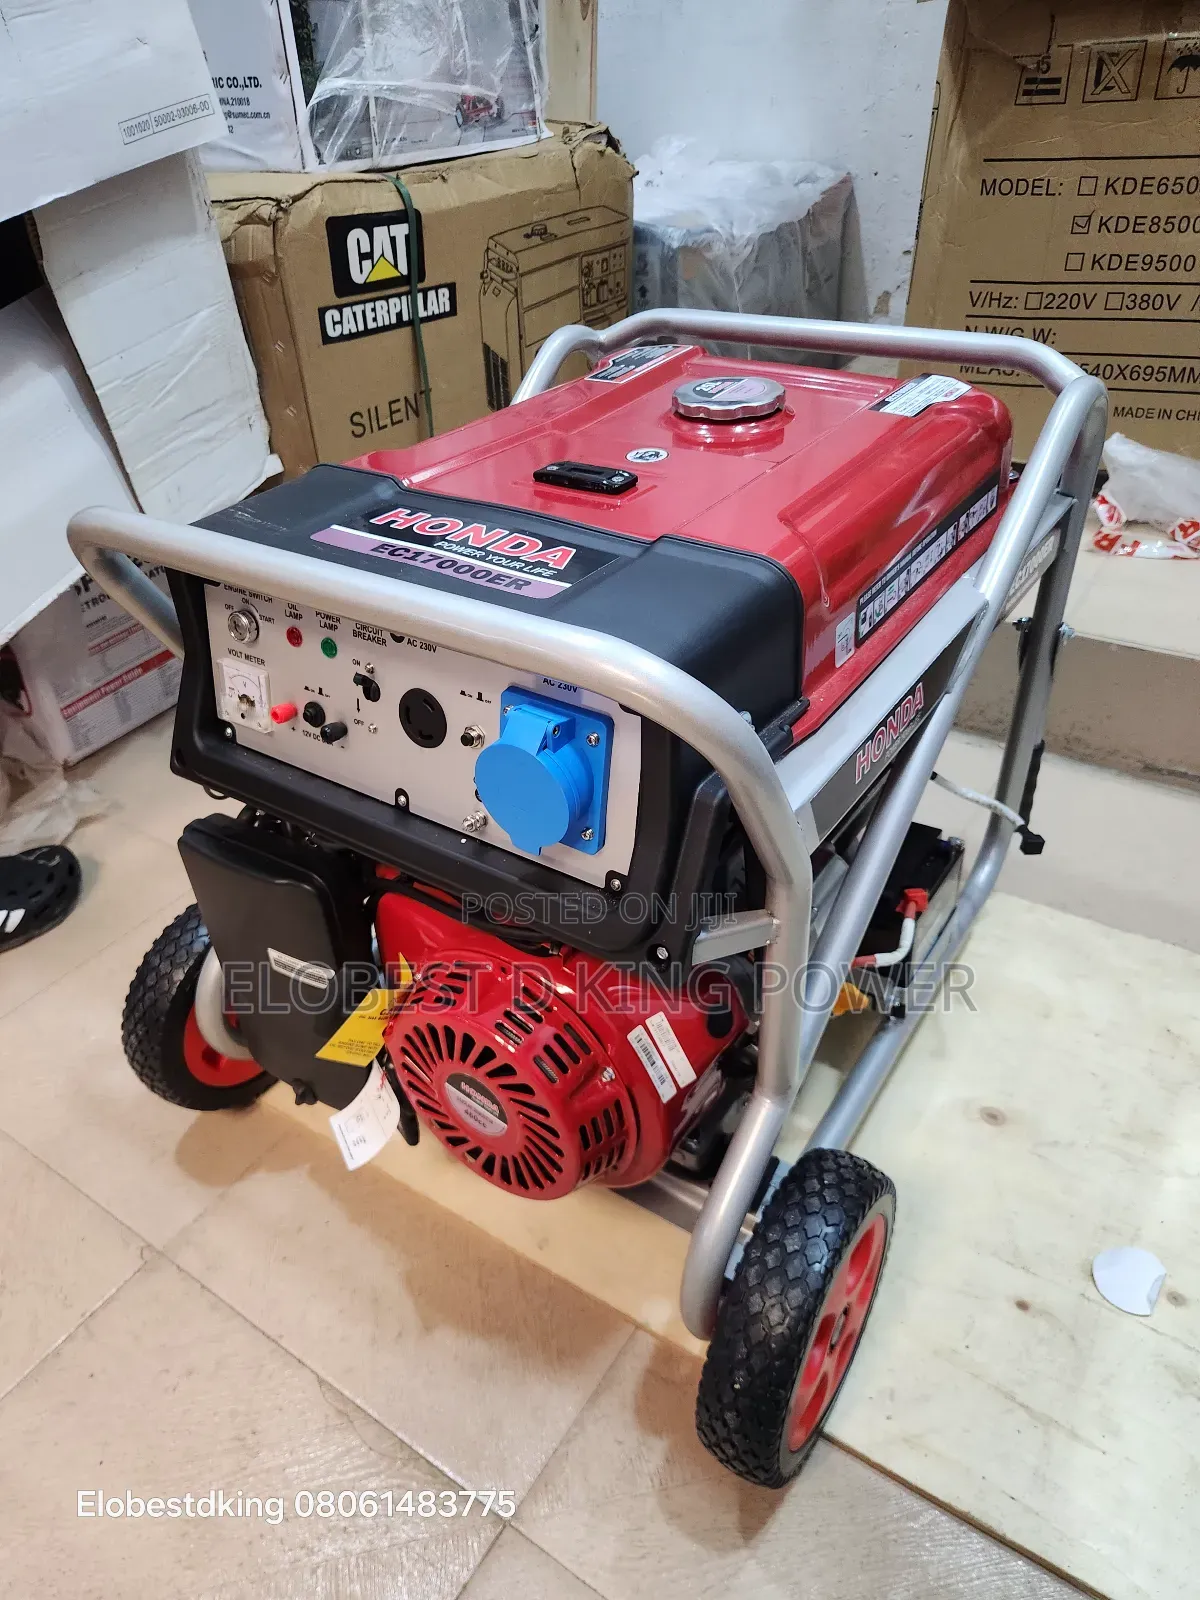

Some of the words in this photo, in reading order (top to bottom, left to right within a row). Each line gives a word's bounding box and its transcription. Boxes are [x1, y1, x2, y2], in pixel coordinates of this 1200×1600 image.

[226, 76, 262, 90] CO.,LTD.
[980, 178, 1064, 196] MODEL:
[347, 224, 410, 284] CAT
[1091, 254, 1196, 272] KDE9500
[969, 291, 1018, 308] V/Hz:
[1044, 293, 1097, 310] 220V
[1126, 294, 1182, 311] 380V
[1113, 406, 1157, 420] MADE
[1158, 409, 1172, 420] IN
[370, 507, 577, 570] HONDA
[370, 544, 532, 590] EC17000ER
[434, 541, 485, 558] POWER
[485, 553, 522, 570] YOUR
[522, 565, 558, 578] LIFE
[284, 610, 303, 620] LAMP
[288, 603, 299, 612] OIL
[259, 614, 274, 624] START
[315, 610, 341, 624] POWER
[320, 620, 338, 632] LAMP
[355, 622, 384, 637] CIRCUIT
[352, 630, 387, 647] BREAKER
[407, 638, 418, 648] AC
[420, 642, 437, 653] 230V
[228, 648, 242, 659] VOLT
[245, 654, 266, 666] METER
[543, 678, 554, 686] AC
[856, 682, 924, 784] HONDA
